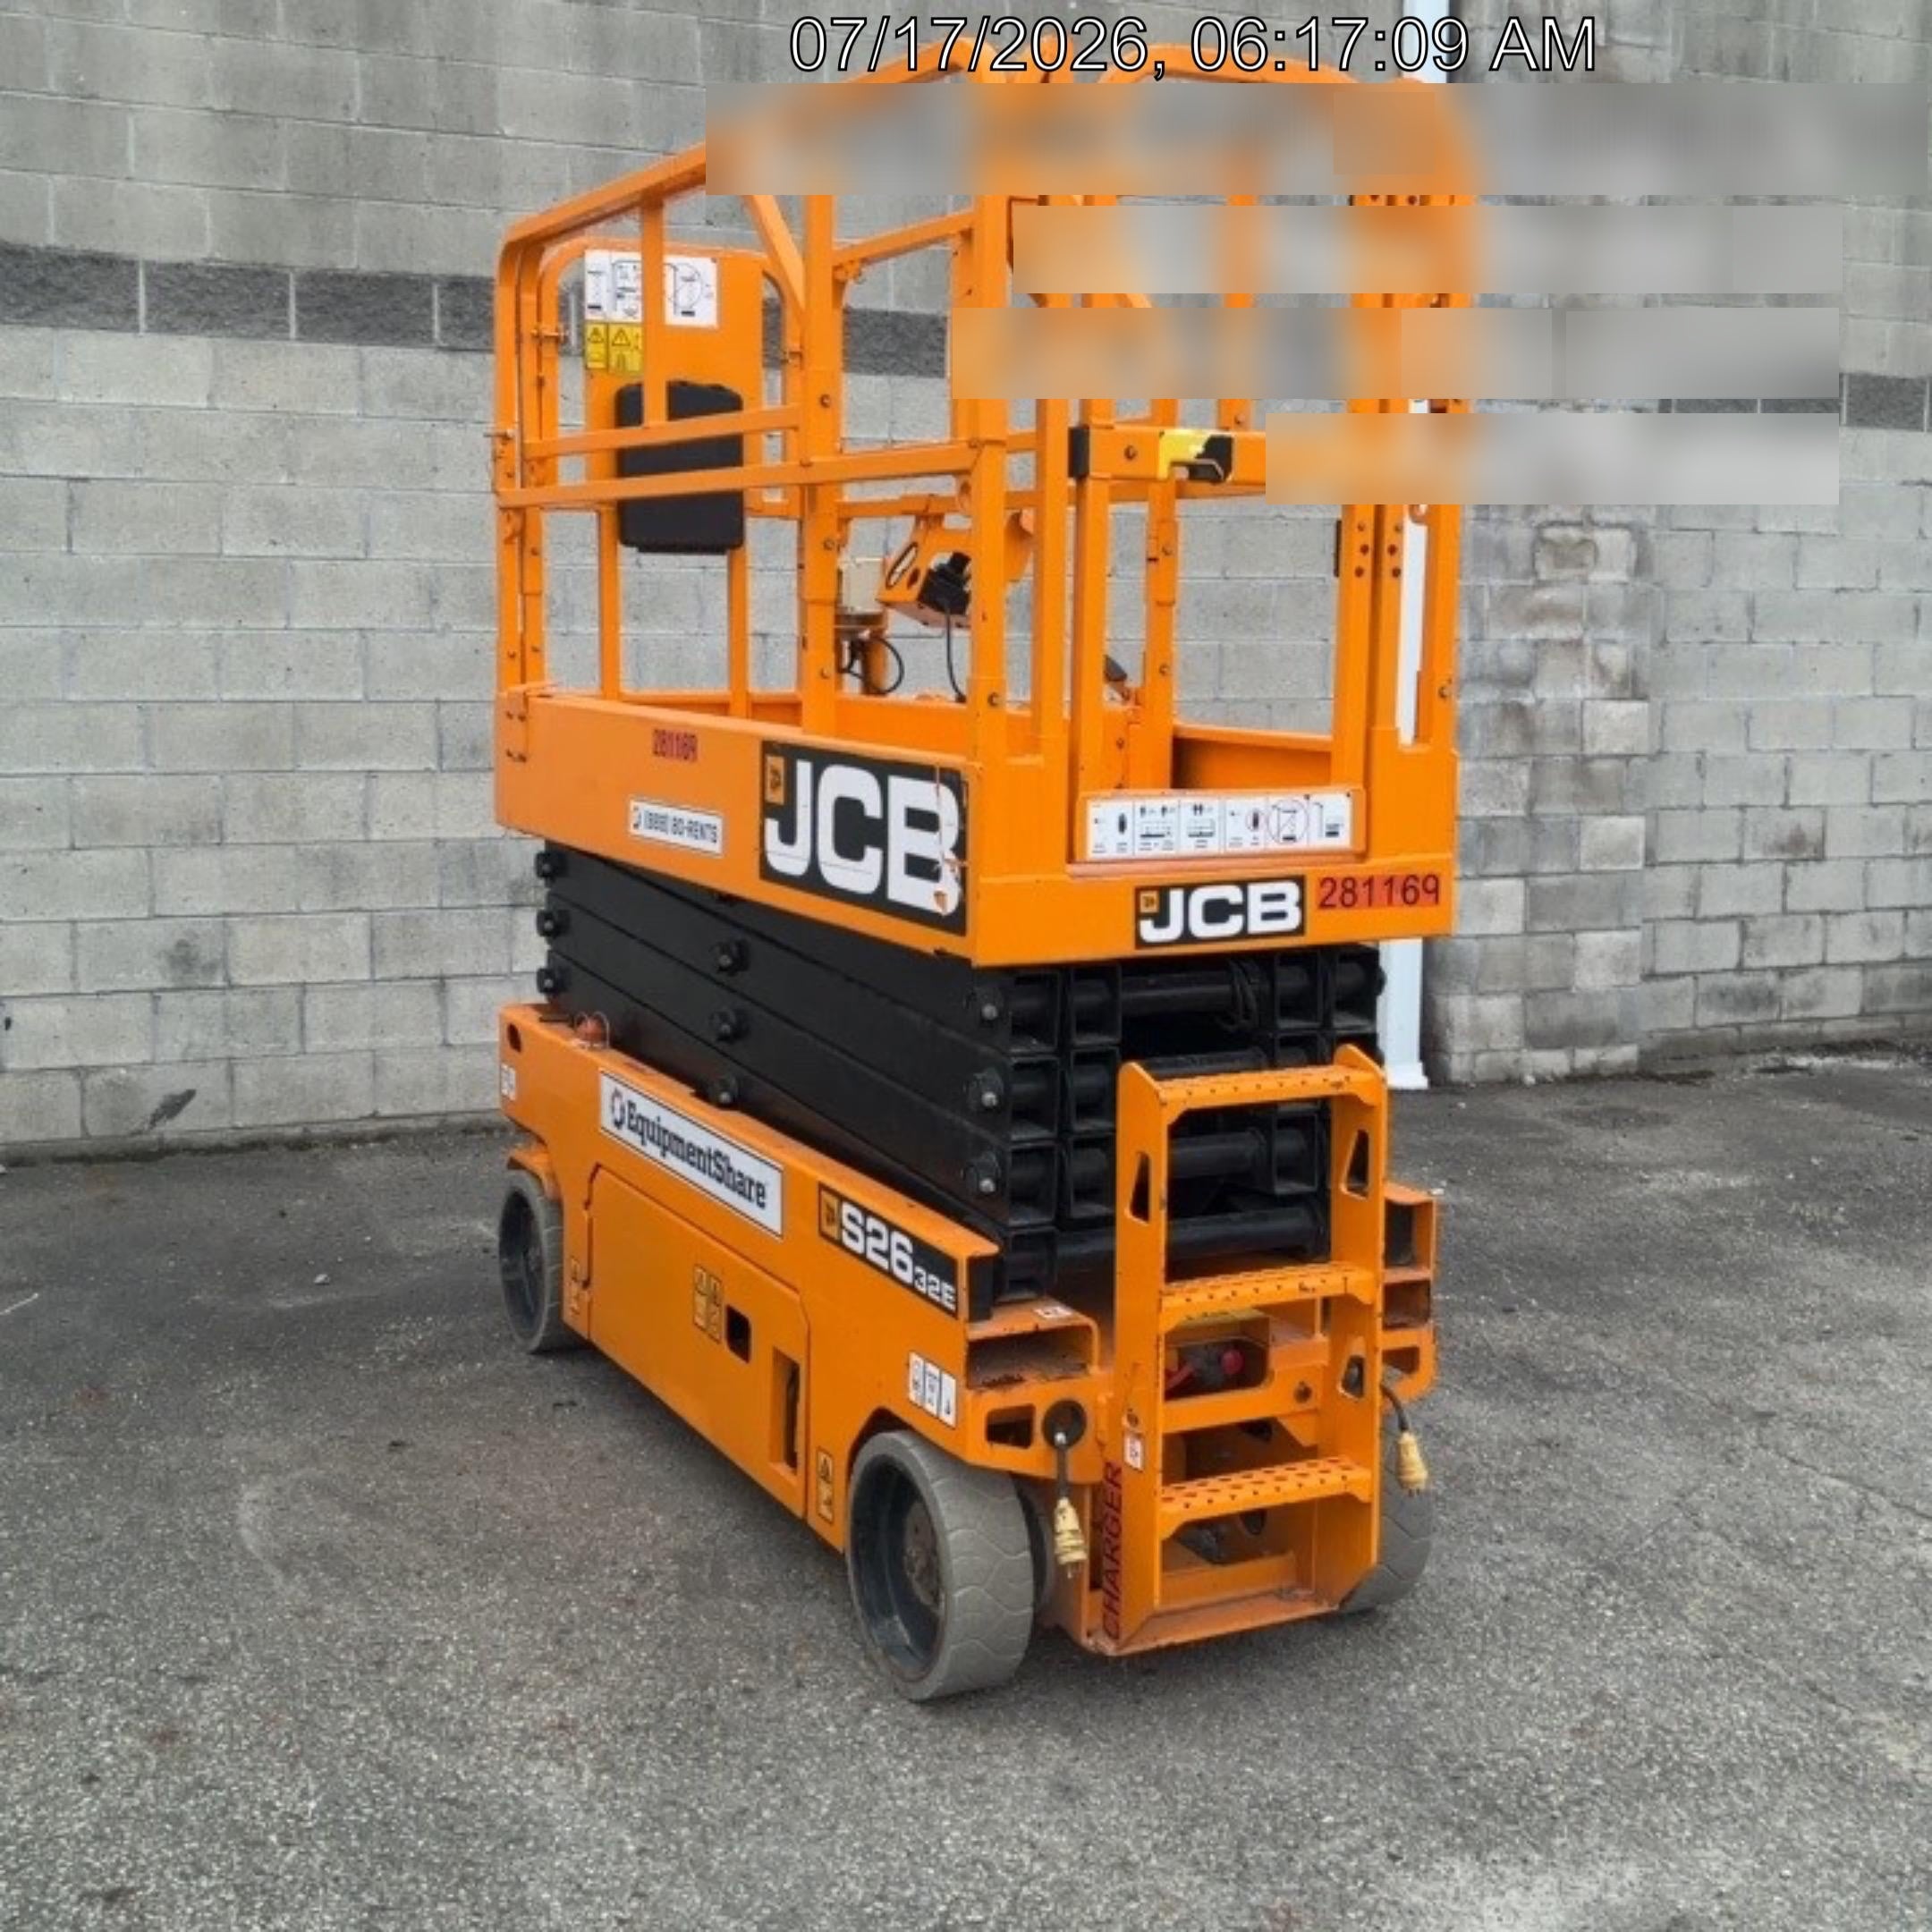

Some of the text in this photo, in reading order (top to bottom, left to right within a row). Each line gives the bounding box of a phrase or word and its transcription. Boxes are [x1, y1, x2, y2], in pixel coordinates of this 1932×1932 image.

[764, 758, 961, 916] JCB
[1318, 874, 1439, 909] 281169
[1139, 880, 1301, 943] JCB
[627, 1100, 766, 1210] EquipmentShare
[1104, 1461, 1122, 1640] CHARGER
